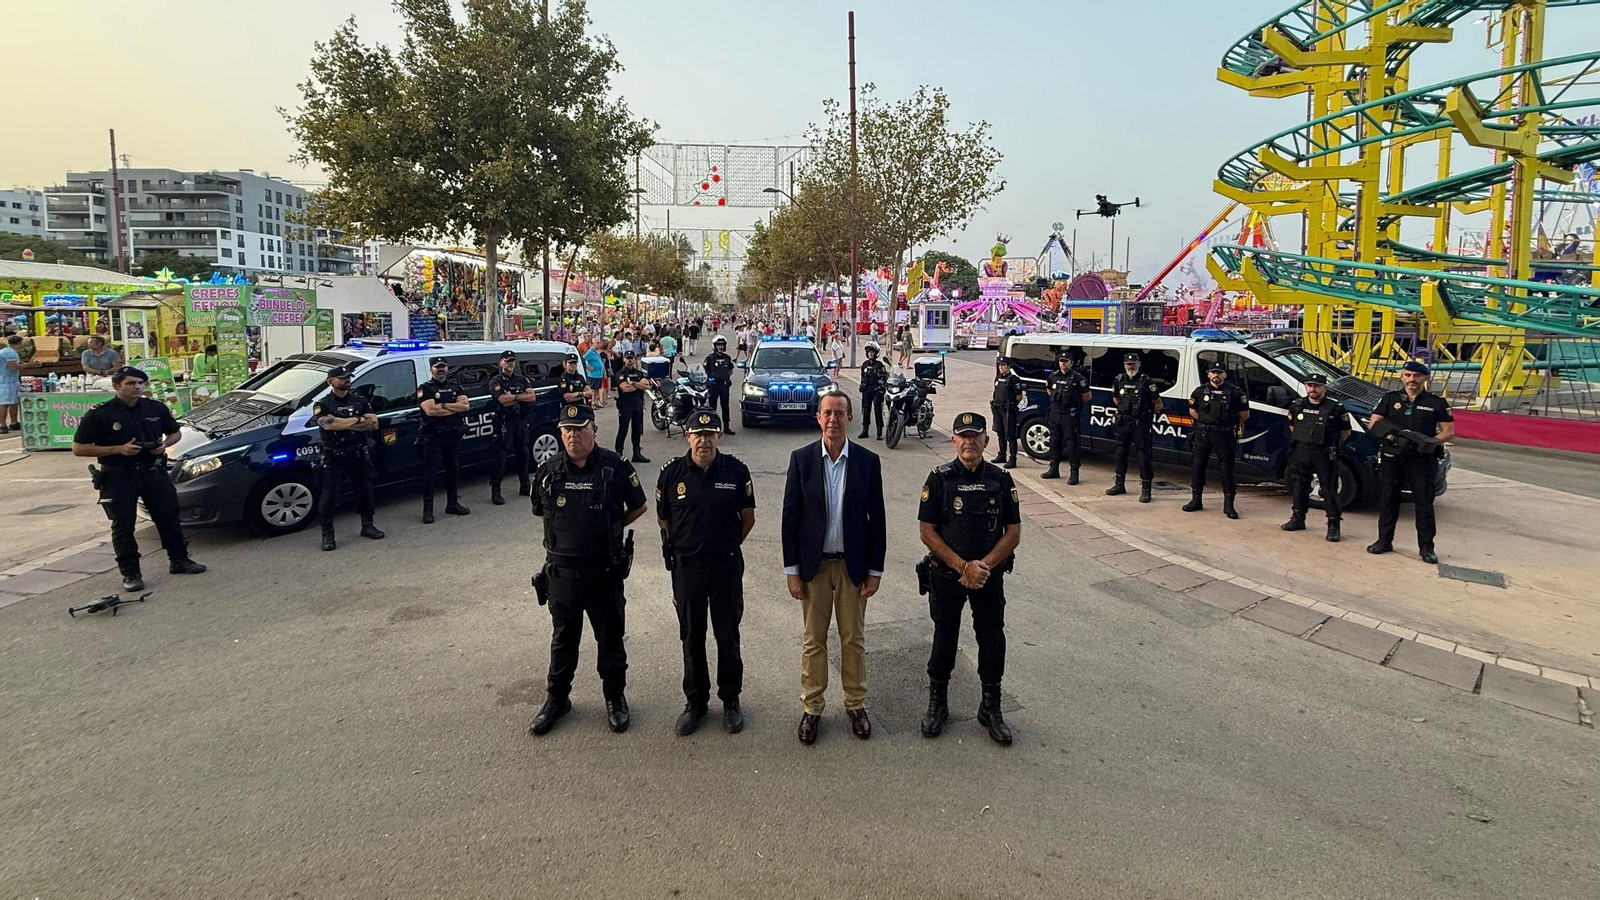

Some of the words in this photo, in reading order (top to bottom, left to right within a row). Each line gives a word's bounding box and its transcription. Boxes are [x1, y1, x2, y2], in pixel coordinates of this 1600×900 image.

[190, 288, 240, 300] CREPES
[259, 297, 306, 311] BUÑUELOS
[272, 313, 305, 324] CREPES
